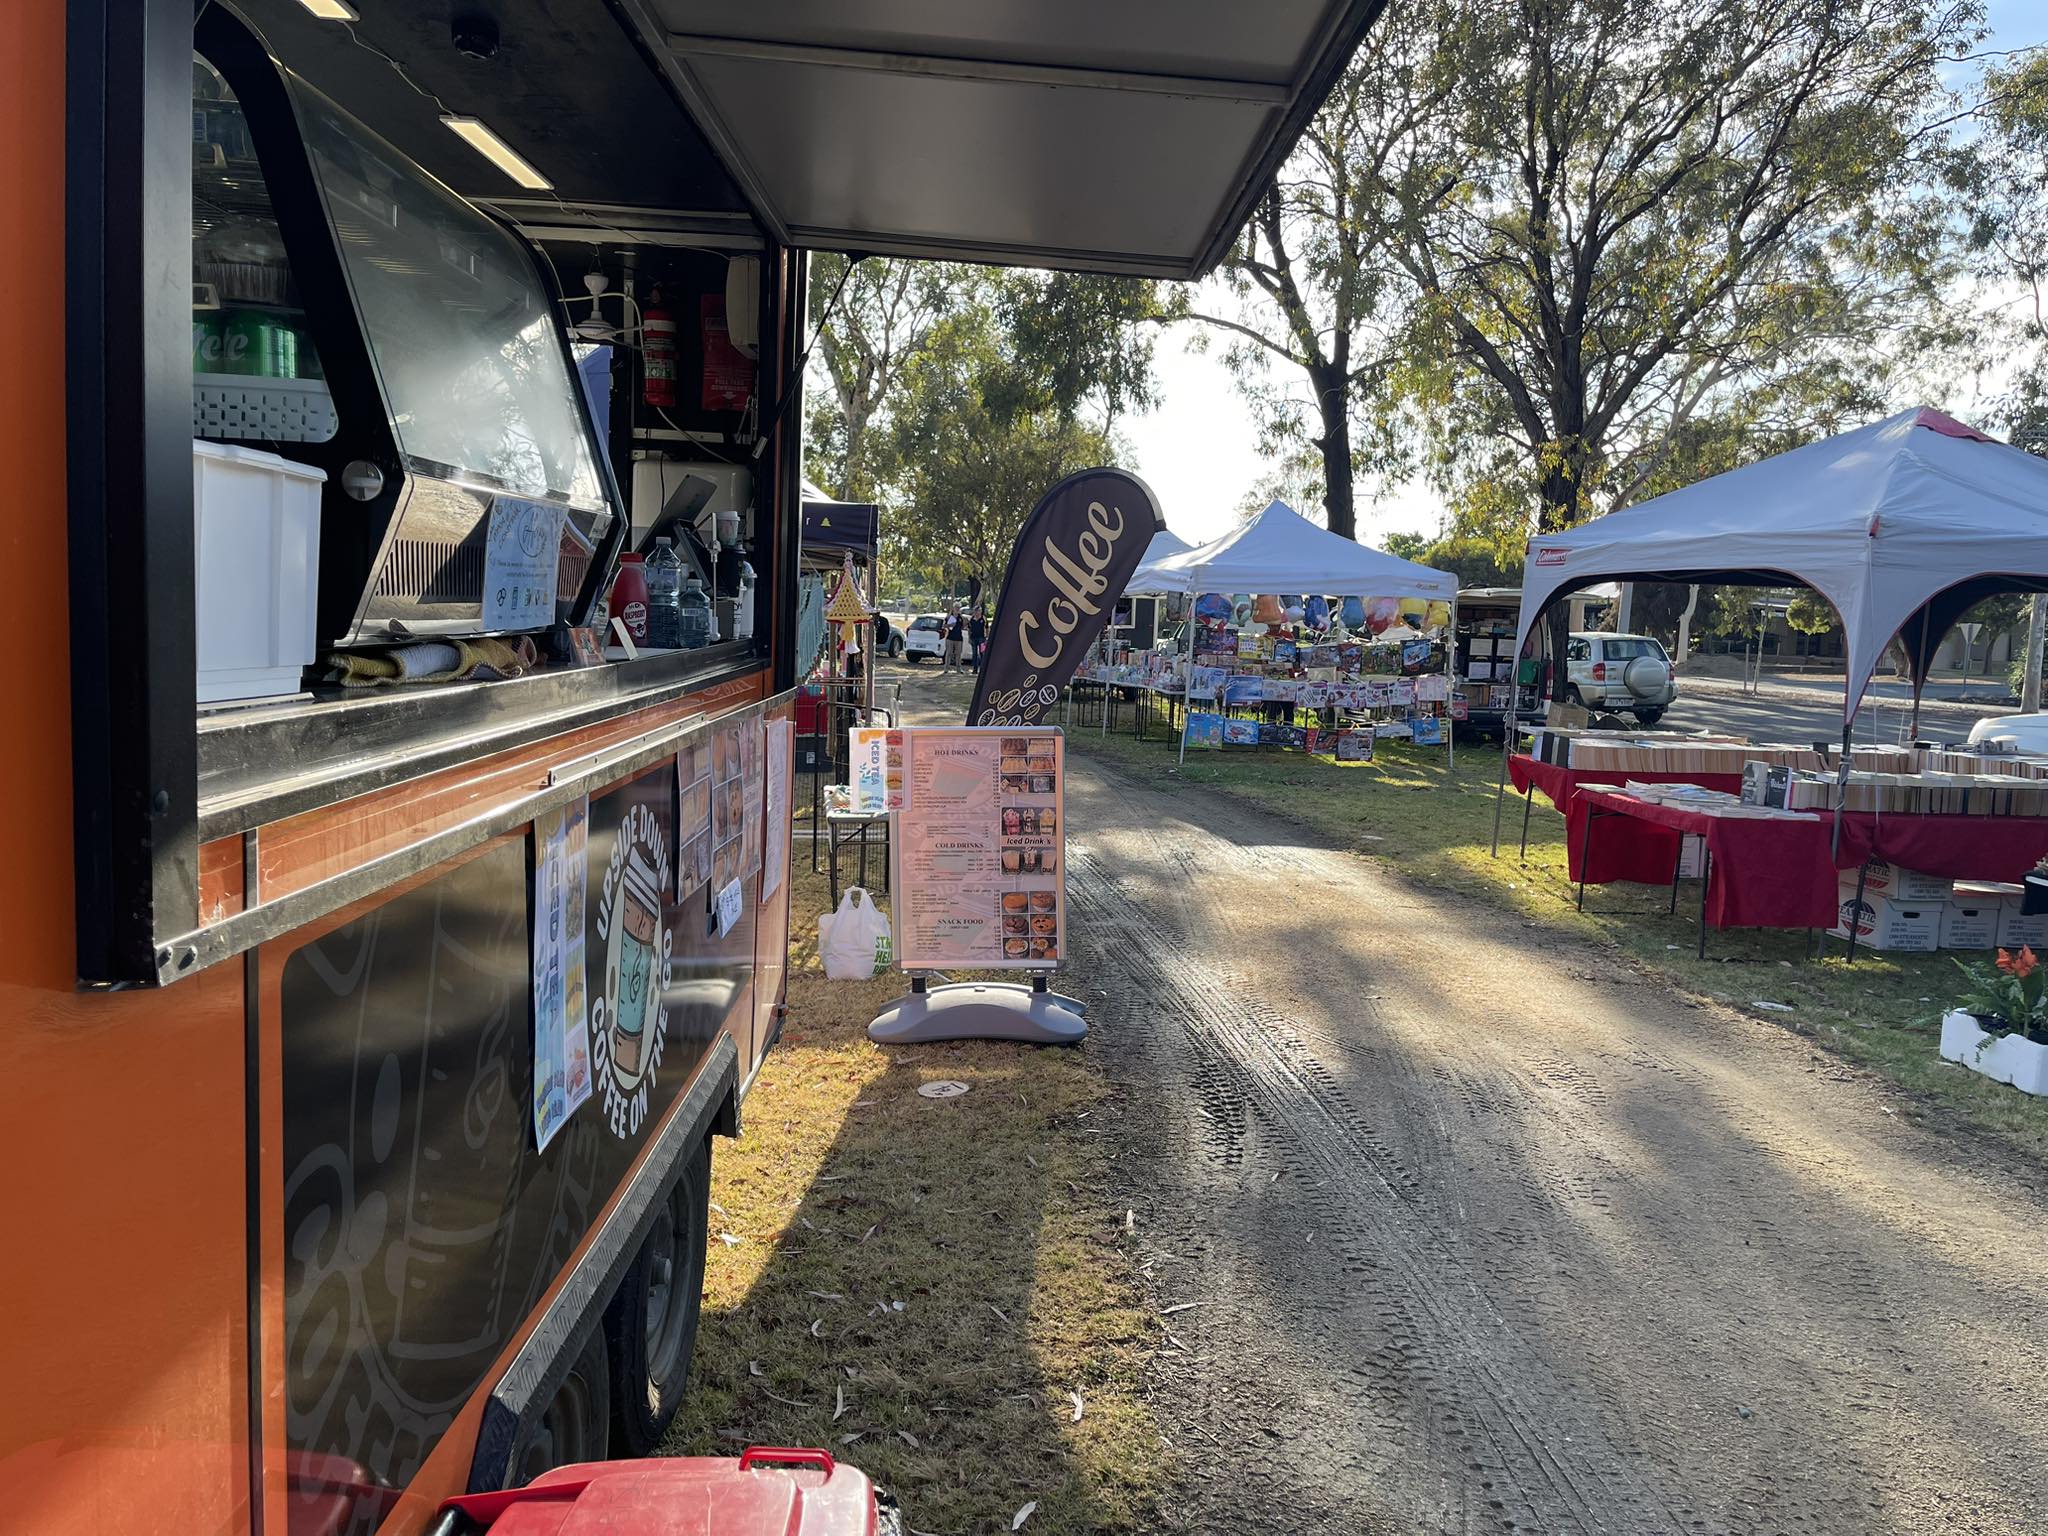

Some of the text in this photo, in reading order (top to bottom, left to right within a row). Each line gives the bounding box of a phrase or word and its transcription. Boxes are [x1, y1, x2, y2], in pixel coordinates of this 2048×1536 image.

[1019, 502, 1124, 669] Coffee
[871, 741, 880, 785] ICED TEA
[597, 803, 670, 941] UPSIDE DOWN
[1007, 837, 1022, 845] Iced
[1024, 837, 1044, 845] Drink
[591, 928, 673, 1140] COFFEE ON THE GO
